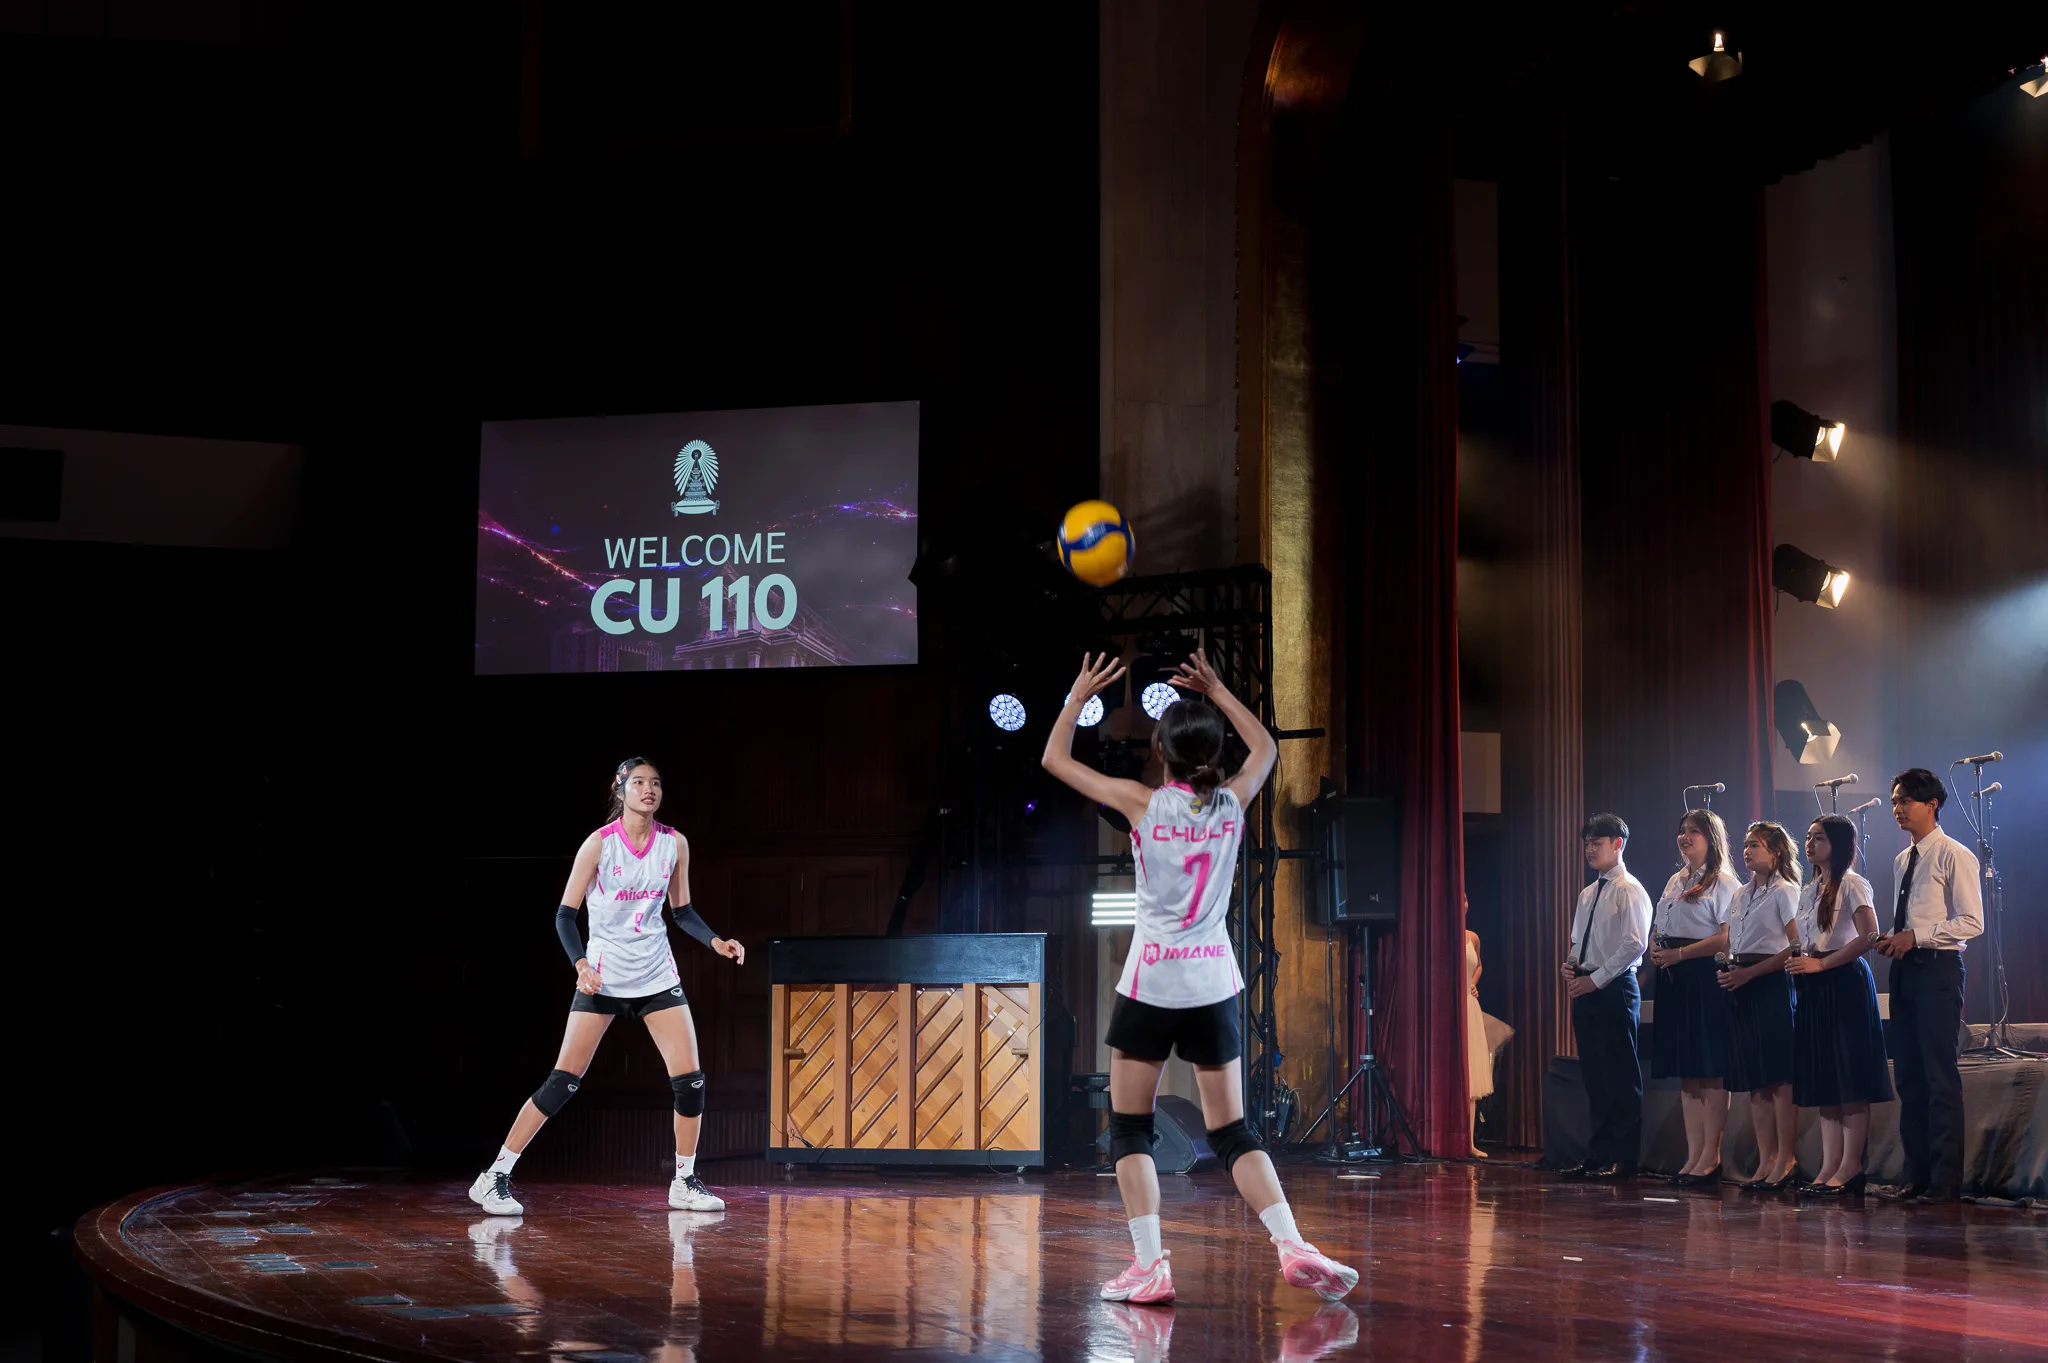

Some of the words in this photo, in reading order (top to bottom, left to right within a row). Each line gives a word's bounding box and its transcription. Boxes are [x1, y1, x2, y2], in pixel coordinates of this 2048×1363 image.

[604, 531, 786, 568] WELCOME
[591, 578, 680, 634] CU
[701, 573, 798, 631] 110
[1153, 821, 1235, 843] CHULA
[1182, 852, 1212, 928] 7
[1163, 944, 1225, 960] IMANE
